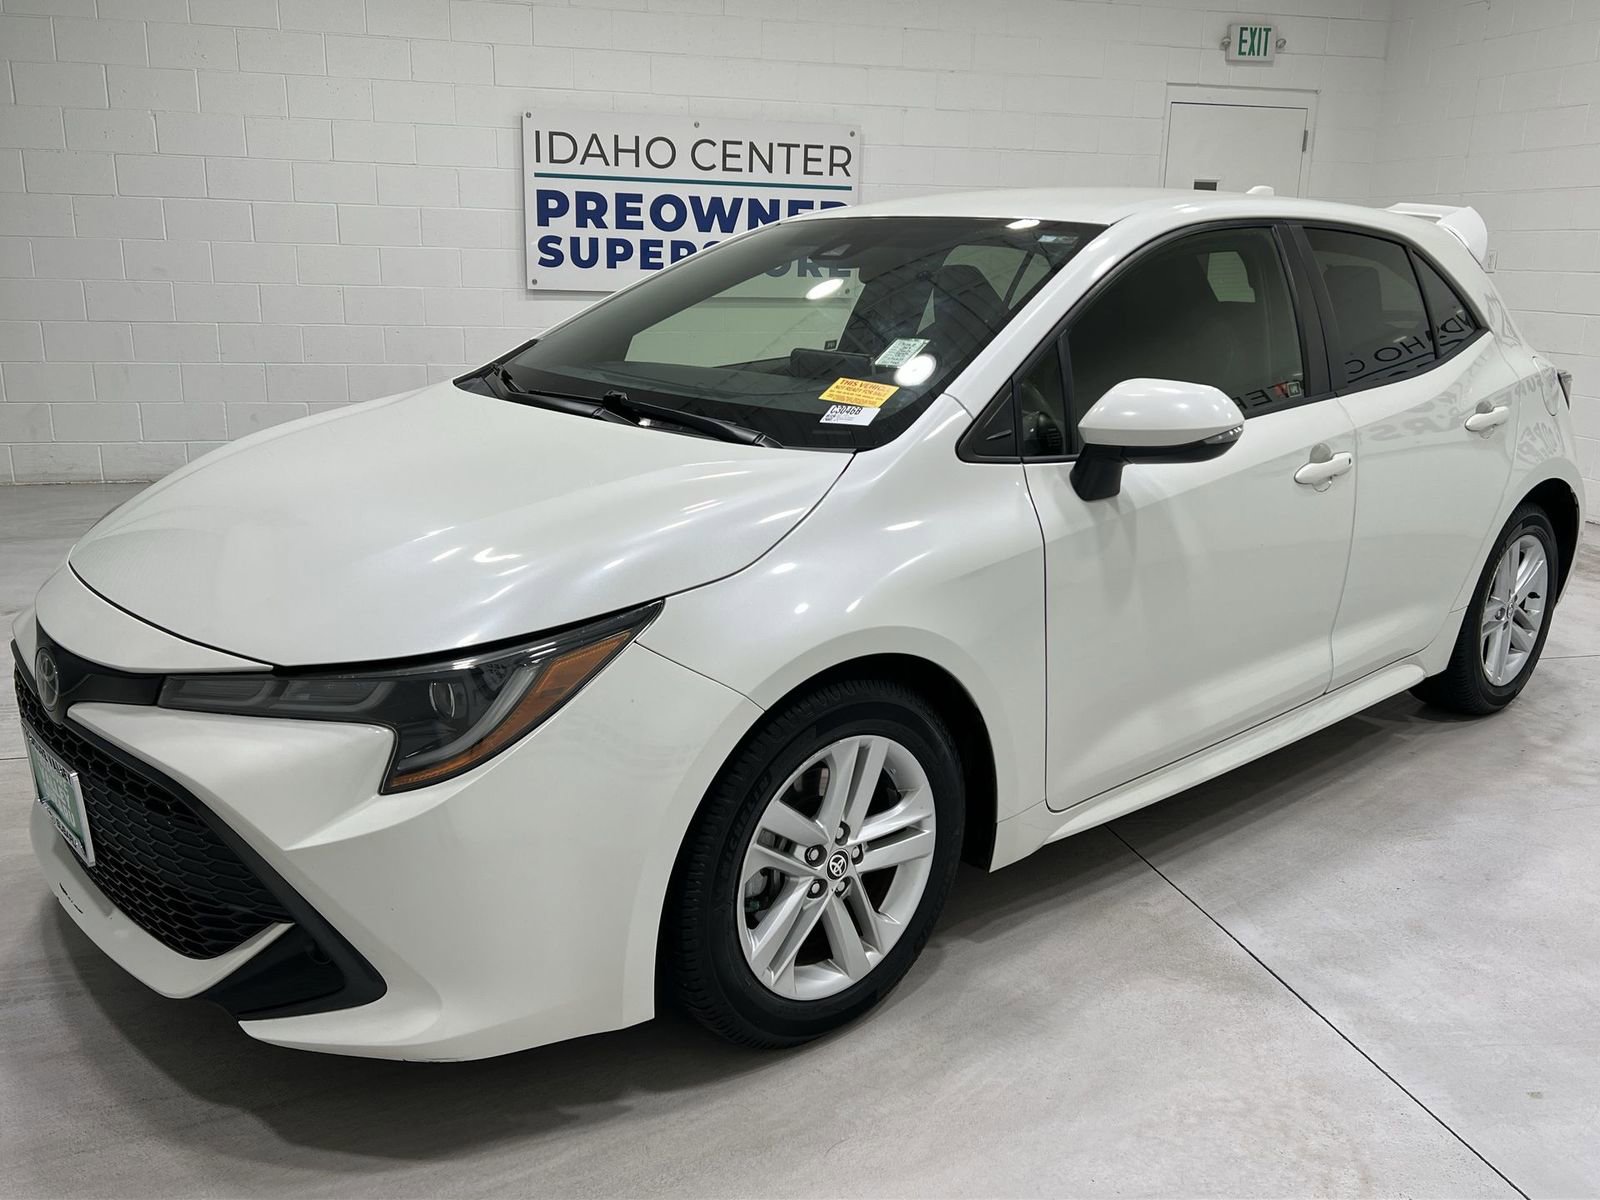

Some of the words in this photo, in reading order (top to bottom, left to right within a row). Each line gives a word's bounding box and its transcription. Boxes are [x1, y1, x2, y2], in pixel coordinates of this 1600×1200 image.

[1238, 26, 1272, 57] EXIT
[534, 130, 677, 170] IDAHO
[690, 138, 852, 177] CENTER
[536, 189, 848, 234] PREOWN
